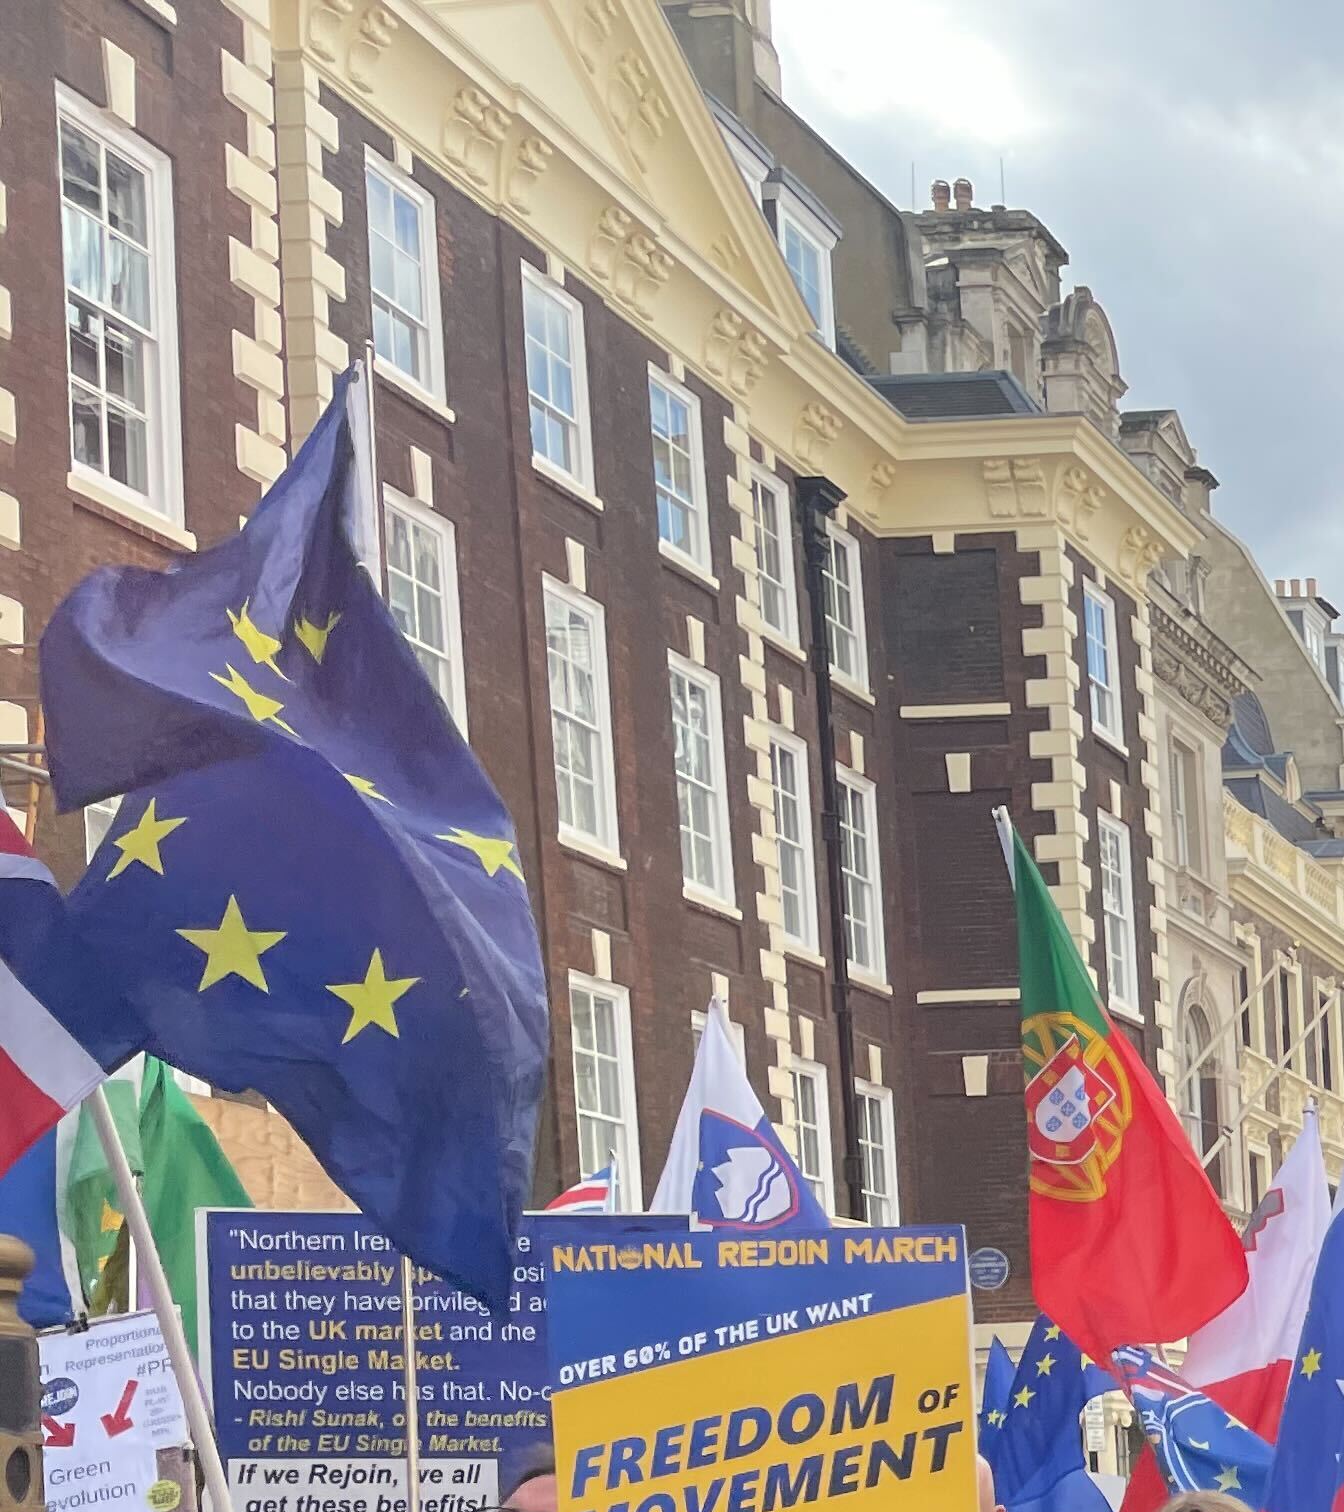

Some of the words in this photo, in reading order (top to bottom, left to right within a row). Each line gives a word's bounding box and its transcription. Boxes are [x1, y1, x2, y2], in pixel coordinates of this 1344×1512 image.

[229, 1229, 345, 1251] "Northern
[718, 1239, 829, 1268] REJOIN
[844, 1236, 957, 1265] MARCH
[231, 1260, 394, 1286] unbelievably
[231, 1291, 277, 1310] that
[285, 1291, 336, 1316] they
[344, 1291, 401, 1310] have
[231, 1321, 254, 1341] to
[263, 1321, 300, 1341] the
[308, 1320, 347, 1341] UK
[450, 1321, 492, 1341] and
[558, 1353, 617, 1386] OVER
[623, 1342, 672, 1370] 60%
[678, 1333, 708, 1356] OF
[714, 1319, 760, 1347] THE
[765, 1310, 798, 1335] UK
[805, 1292, 874, 1325] WANT
[232, 1349, 269, 1370] EU
[279, 1349, 359, 1375] Single
[234, 1380, 328, 1406] Nobody
[335, 1381, 383, 1400] else
[443, 1381, 491, 1401] that.
[249, 1408, 306, 1427] Rishi
[311, 1408, 384, 1429] Sunak,
[426, 1408, 458, 1428] the
[464, 1408, 546, 1428] benefits
[248, 1434, 270, 1453] of
[277, 1434, 311, 1452] the
[317, 1434, 349, 1452] EU
[429, 1434, 503, 1453] Market.
[571, 1373, 896, 1499] FREEDOM
[917, 1383, 960, 1414] OF
[48, 1458, 112, 1486] Green
[237, 1463, 257, 1485] If
[264, 1468, 299, 1485] we
[308, 1463, 398, 1490] Rejoin,
[451, 1463, 481, 1485] all
